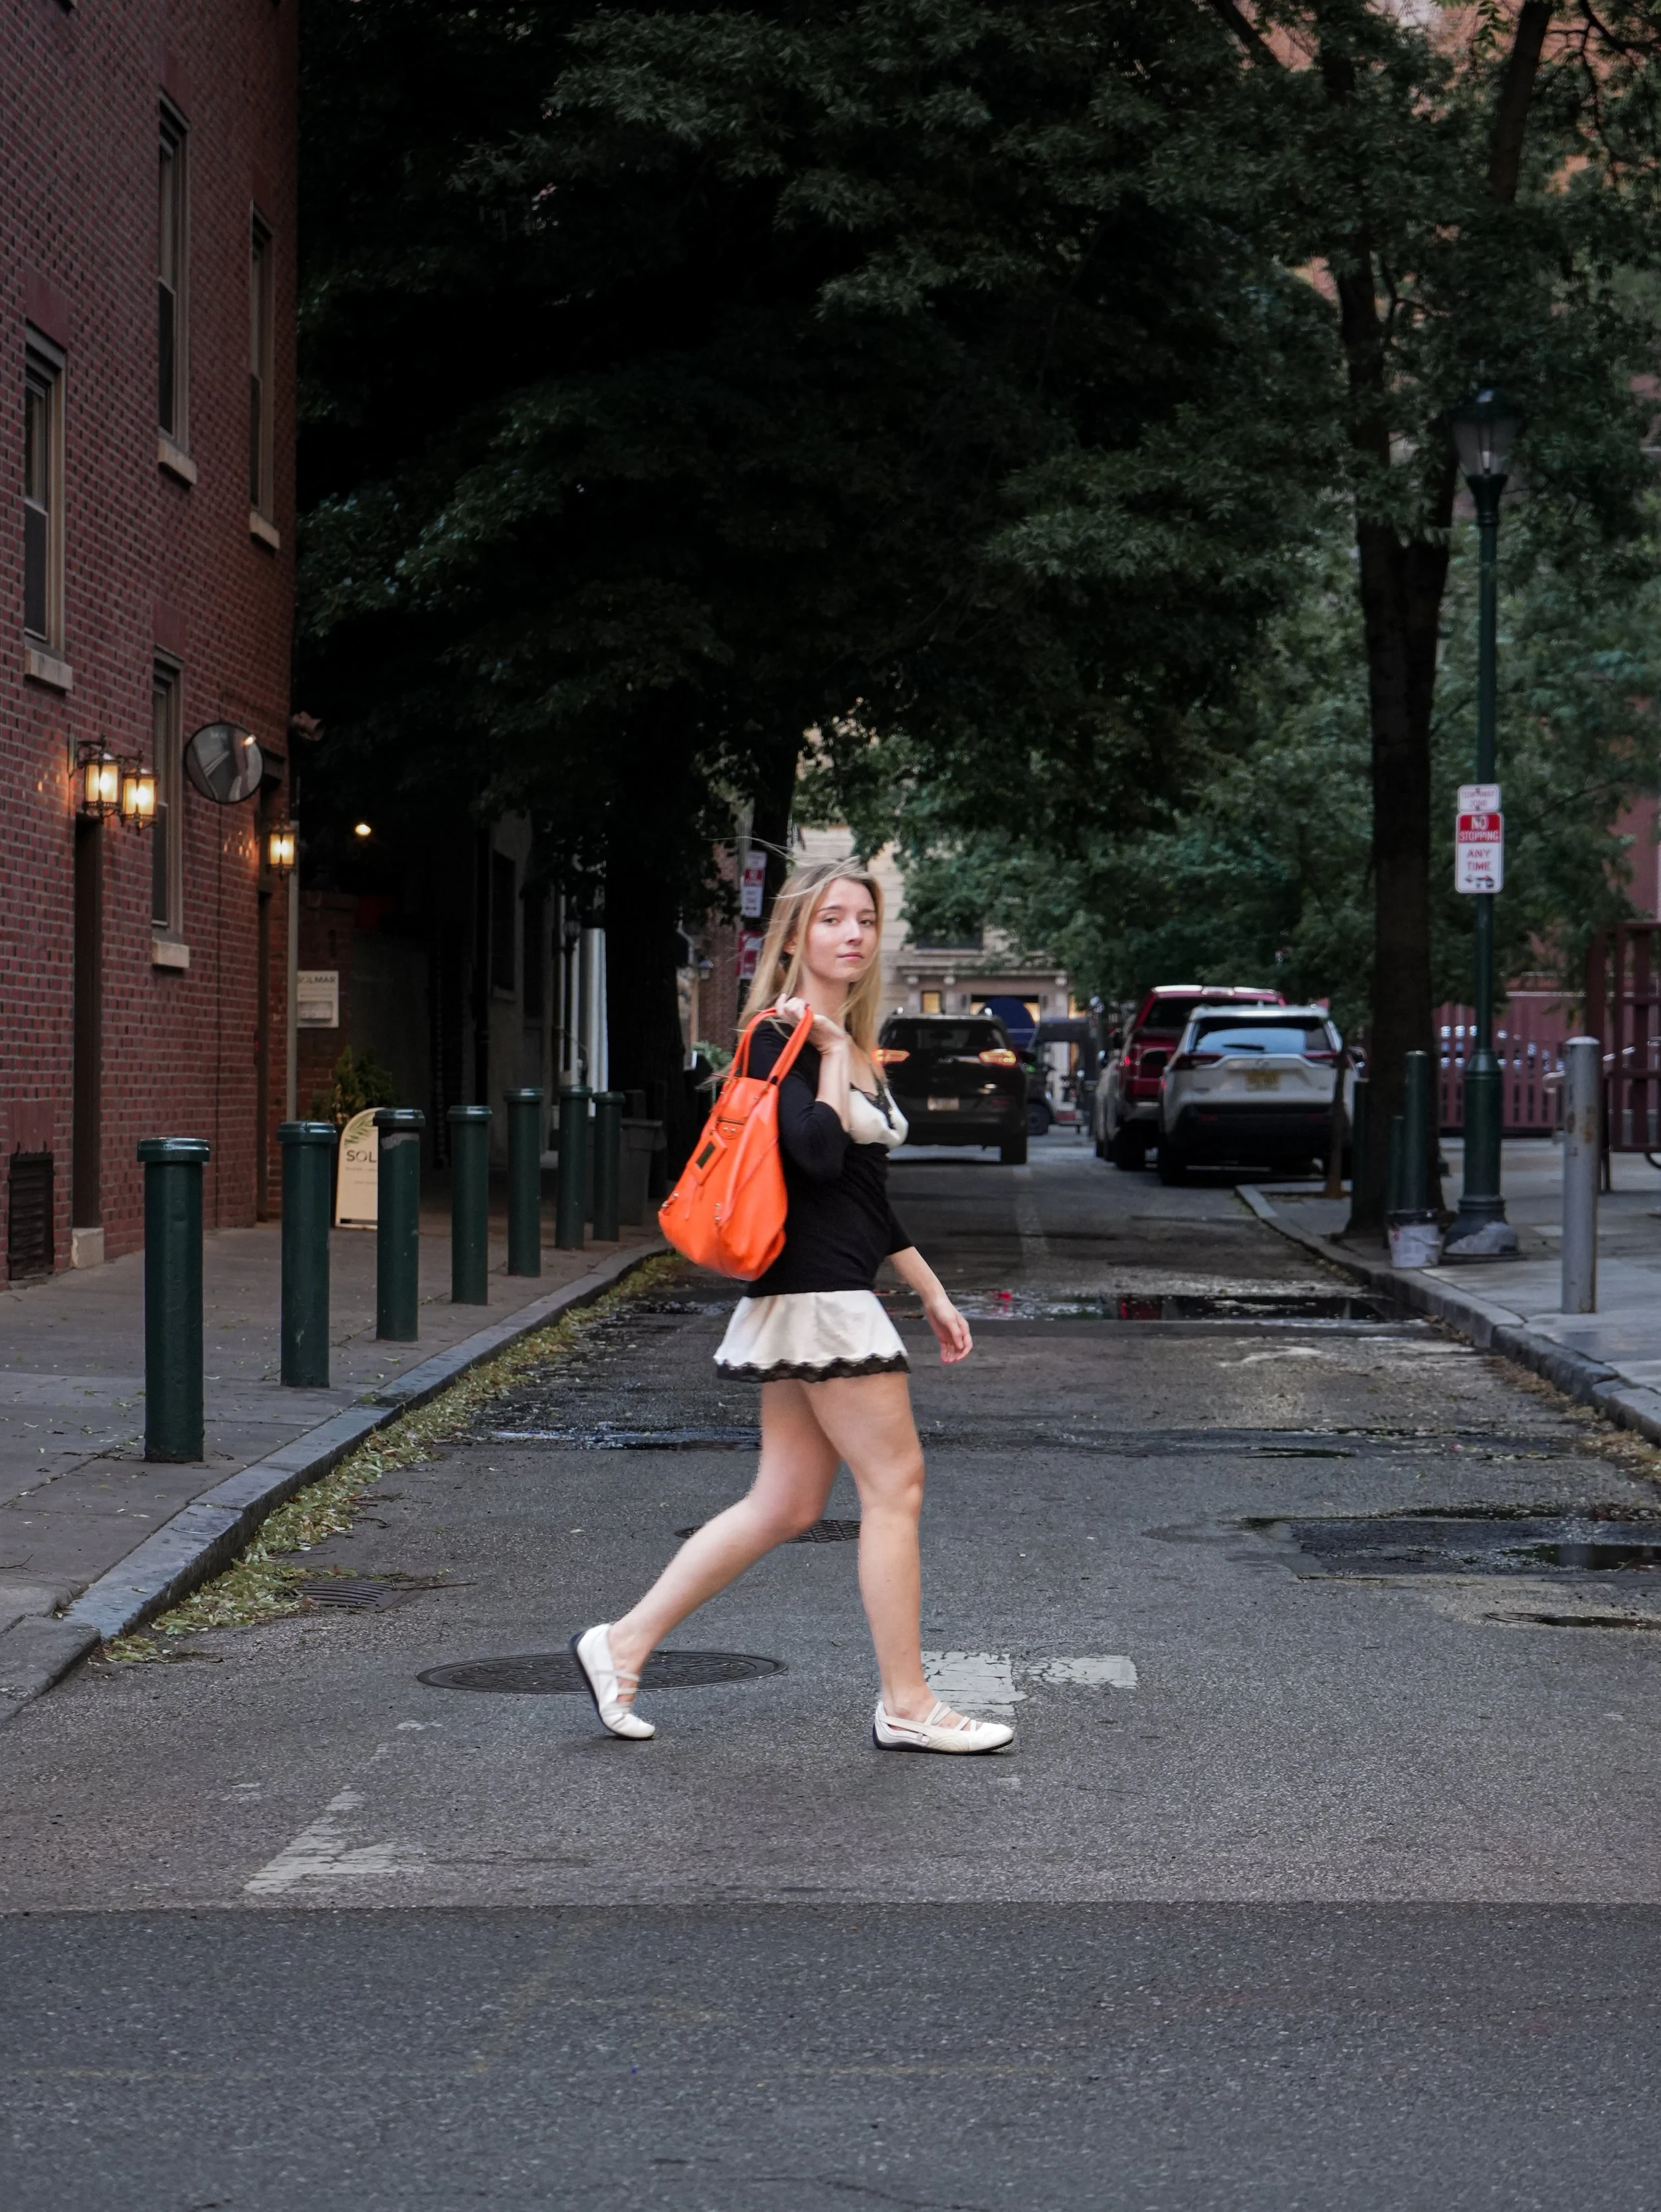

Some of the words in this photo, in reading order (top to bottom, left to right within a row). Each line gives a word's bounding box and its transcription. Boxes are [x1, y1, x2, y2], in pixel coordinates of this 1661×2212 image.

[1471, 815, 1490, 830] NO
[1459, 831, 1499, 842] STOPPING
[1466, 849, 1492, 858] ANY
[1466, 861, 1491, 872] TIME
